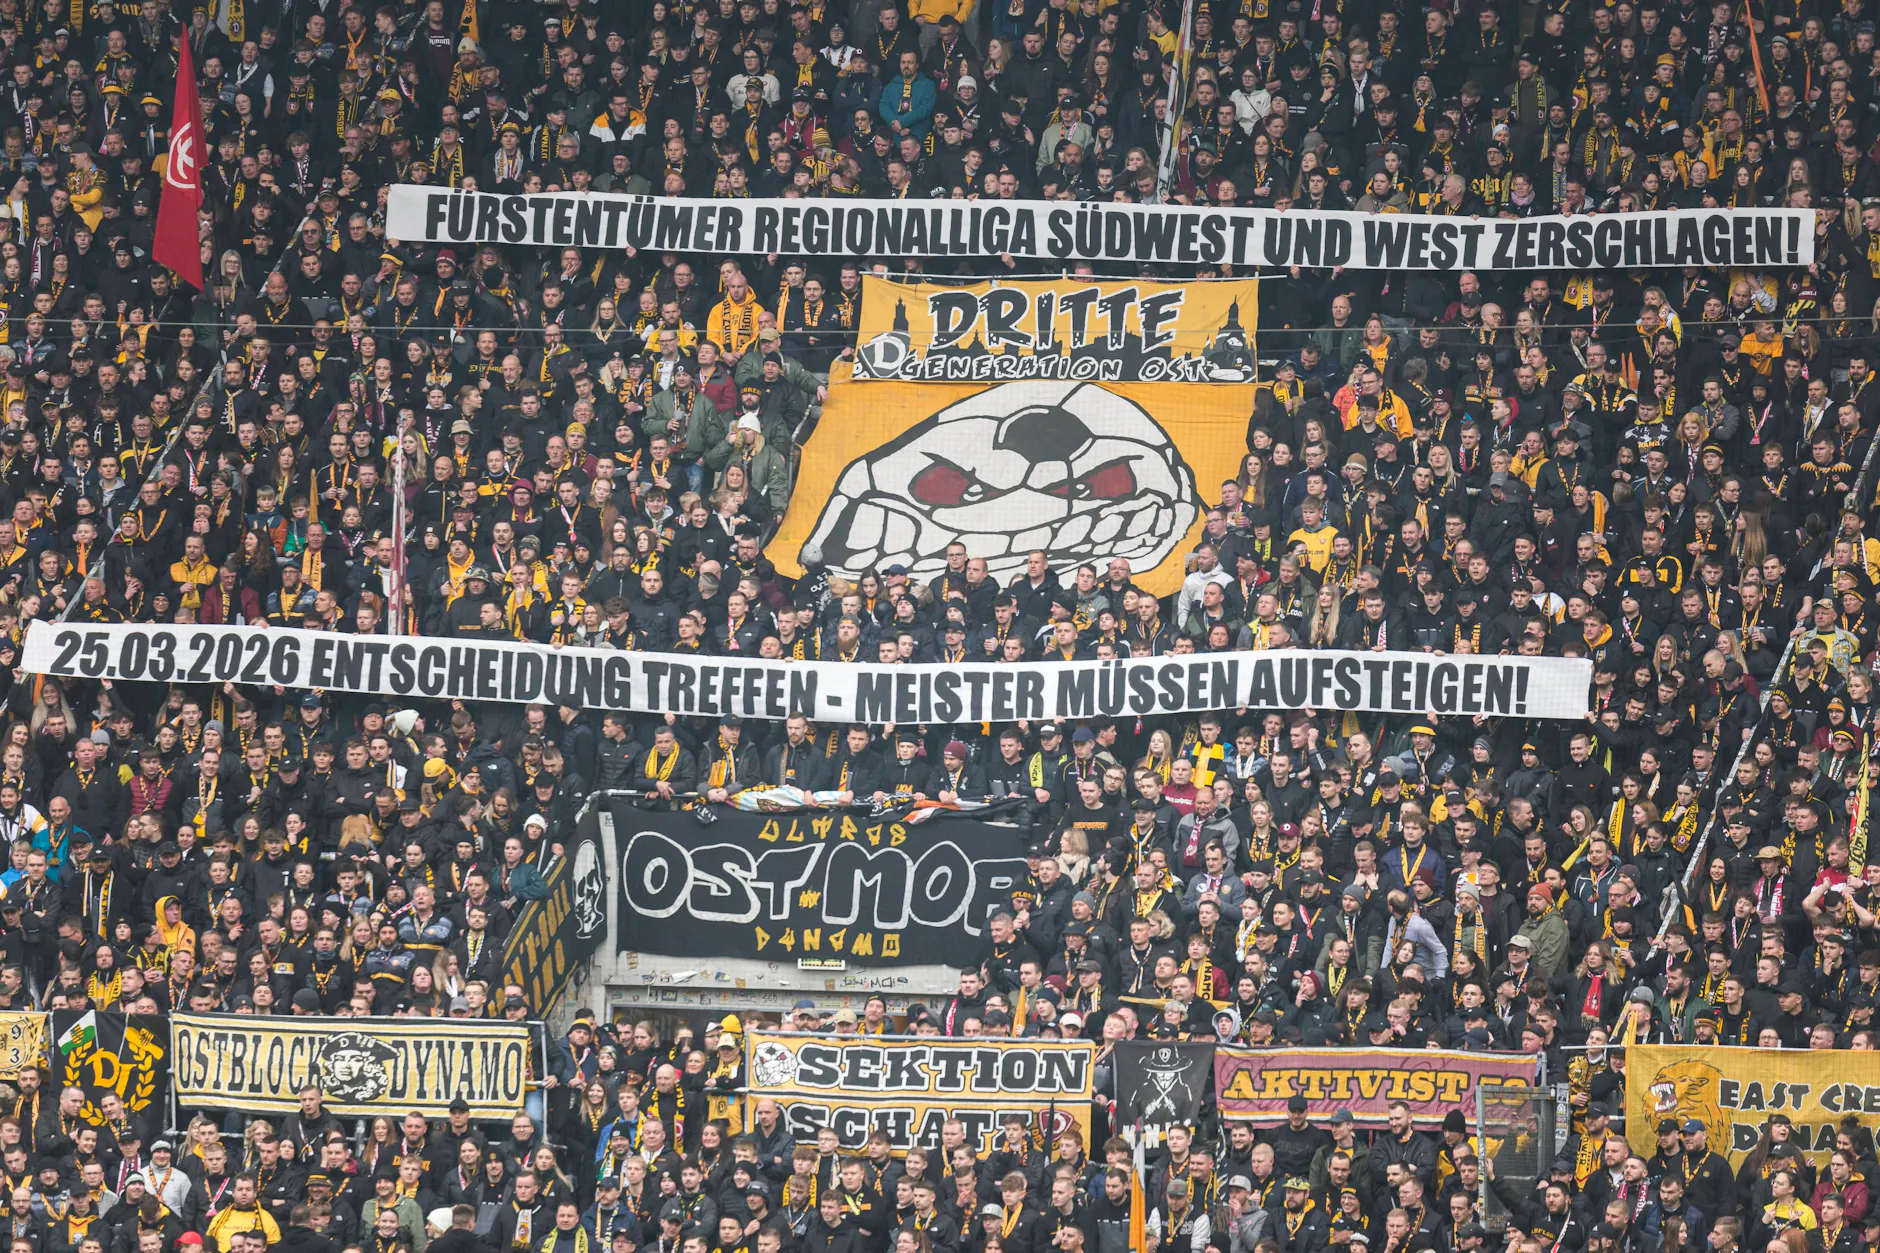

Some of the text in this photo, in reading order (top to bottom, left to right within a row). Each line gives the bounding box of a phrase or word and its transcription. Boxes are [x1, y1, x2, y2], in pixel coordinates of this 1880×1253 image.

[425, 188, 1801, 269] FÜRSTENTÜMER REGIONALLIGA SÜDWEST UND WEST ZERSCHLAGEN!
[927, 286, 1186, 354] DRITTE
[898, 349, 1209, 382] GENERATION OST
[50, 630, 301, 685] 25.03.2026
[308, 637, 631, 708] ENTSCHEIDUNG
[642, 660, 819, 718] TREFFEN
[855, 669, 1044, 722] MEISTER
[1056, 657, 1239, 718] MÜSSEN
[1248, 657, 1530, 715] AUFSTEIGEN!
[758, 815, 906, 846] ULTRAS
[178, 1028, 523, 1101] OSTBLOCK DYNAMO
[795, 1044, 1091, 1094] SEKTION
[1221, 1067, 1470, 1103] AKTIVIST
[1719, 1078, 1811, 1112] EAST
[754, 1102, 1033, 1152] SCHAT
